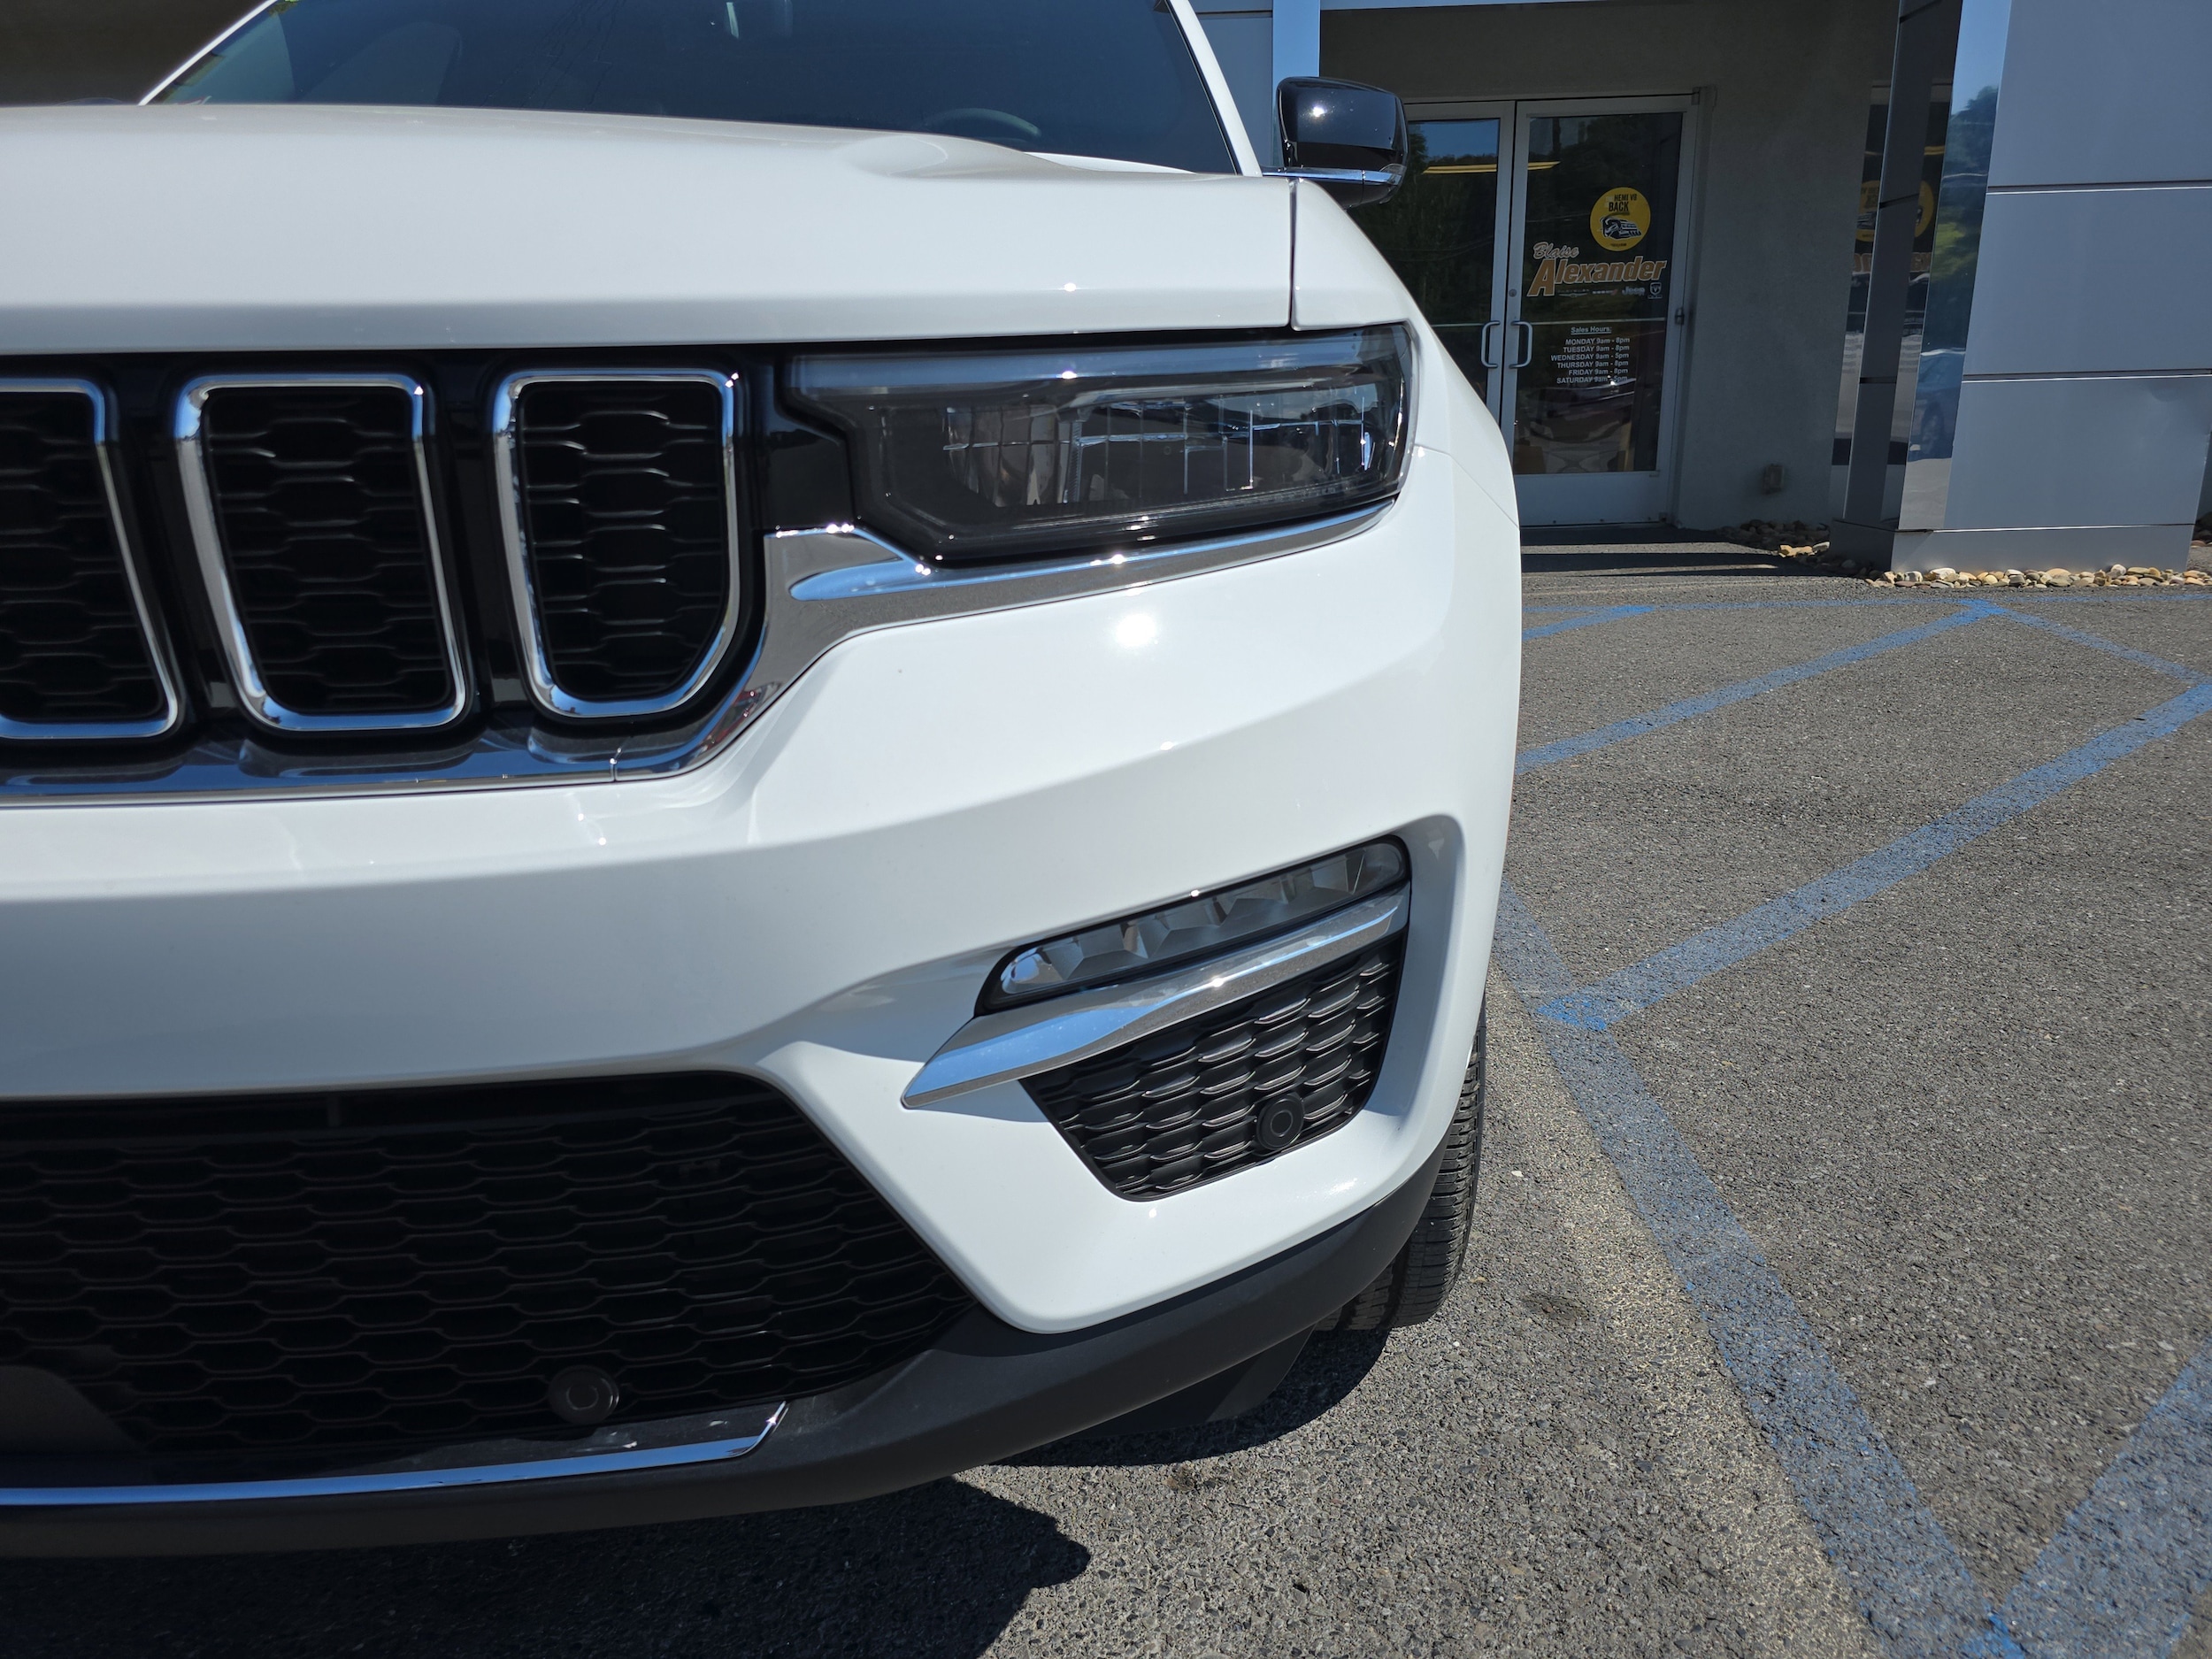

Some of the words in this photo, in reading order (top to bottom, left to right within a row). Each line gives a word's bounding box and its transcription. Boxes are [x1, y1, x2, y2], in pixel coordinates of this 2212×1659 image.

[1609, 201, 1629, 211] BACK
[1532, 242, 1579, 259] Blaise
[1526, 255, 1668, 297] Alexander
[1622, 286, 1646, 296] Jeep
